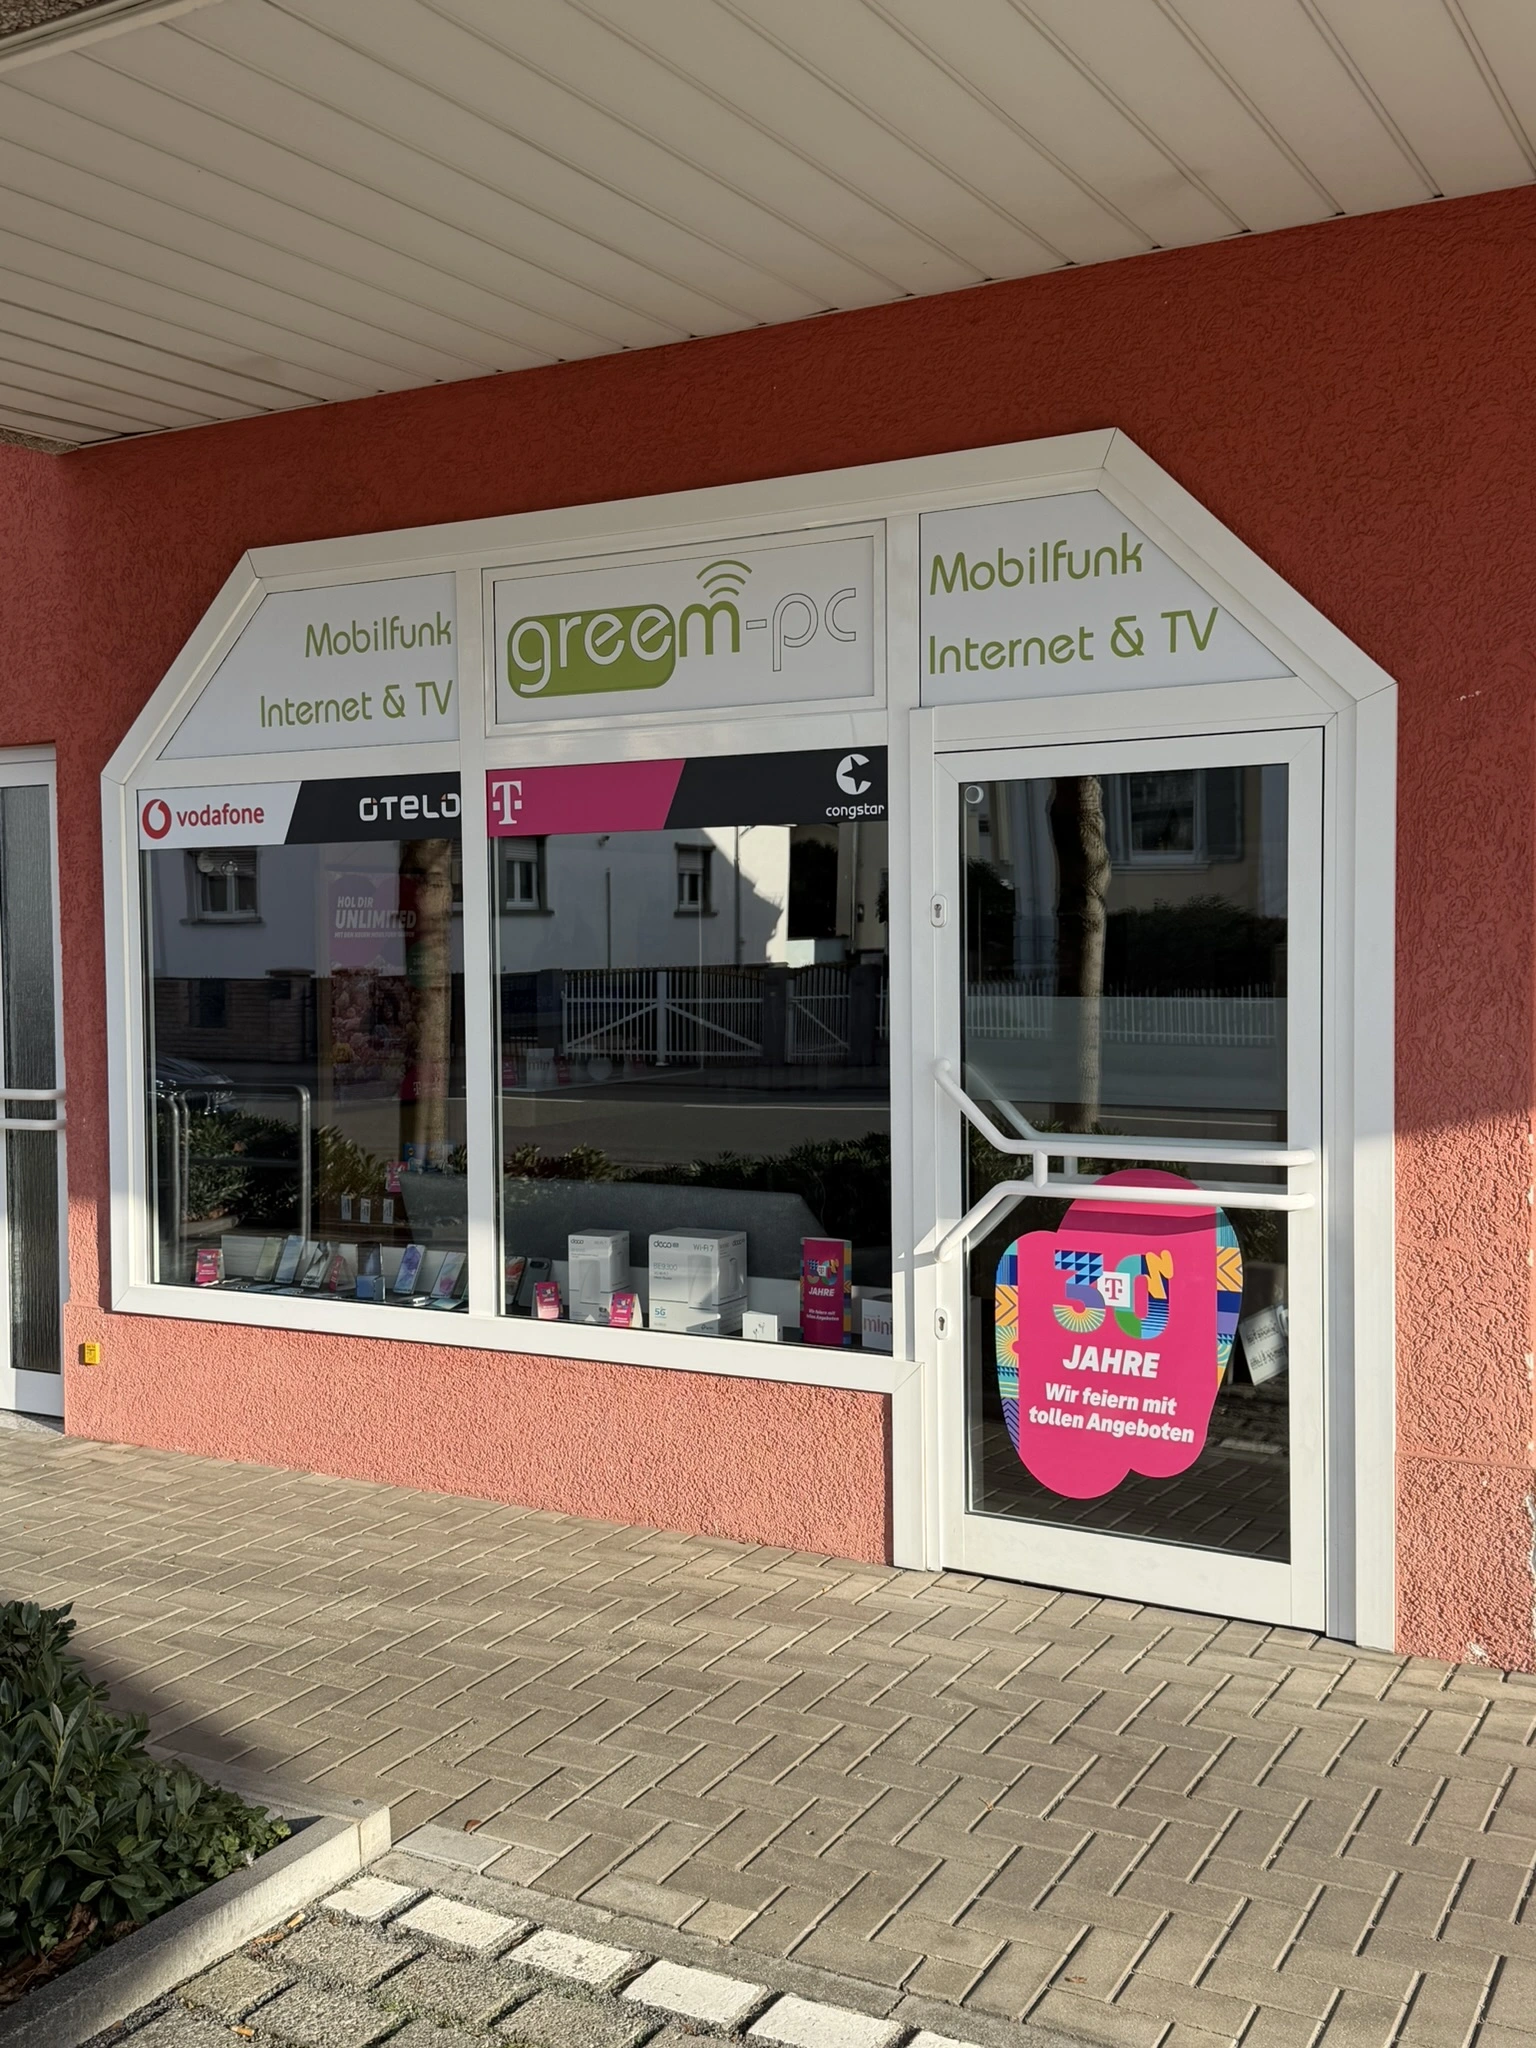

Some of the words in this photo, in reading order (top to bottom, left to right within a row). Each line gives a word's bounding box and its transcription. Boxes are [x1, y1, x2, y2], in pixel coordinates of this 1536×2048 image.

[930, 532, 1144, 596] Mobilfunk
[305, 611, 452, 658] Mobilfunk
[929, 626, 1095, 675] Internet
[1110, 616, 1145, 658] &
[1160, 606, 1220, 654] TV
[260, 691, 373, 728] Internet
[383, 686, 406, 719] &
[415, 680, 453, 716] TV
[177, 803, 265, 827] vodafone
[493, 781, 522, 825] T
[826, 803, 885, 820] congstar
[335, 909, 417, 929] UNLIMITED
[337, 896, 356, 908] HOL
[357, 896, 374, 908] DIR
[808, 1286, 836, 1297] JAHRE
[1104, 1278, 1123, 1300] T
[1062, 1344, 1161, 1379] JAHRE
[1045, 1382, 1080, 1404] Wir
[1082, 1386, 1140, 1411] feiern
[1142, 1396, 1178, 1416] mit
[1028, 1405, 1084, 1429] tollen
[1086, 1412, 1195, 1444] Angeboten
